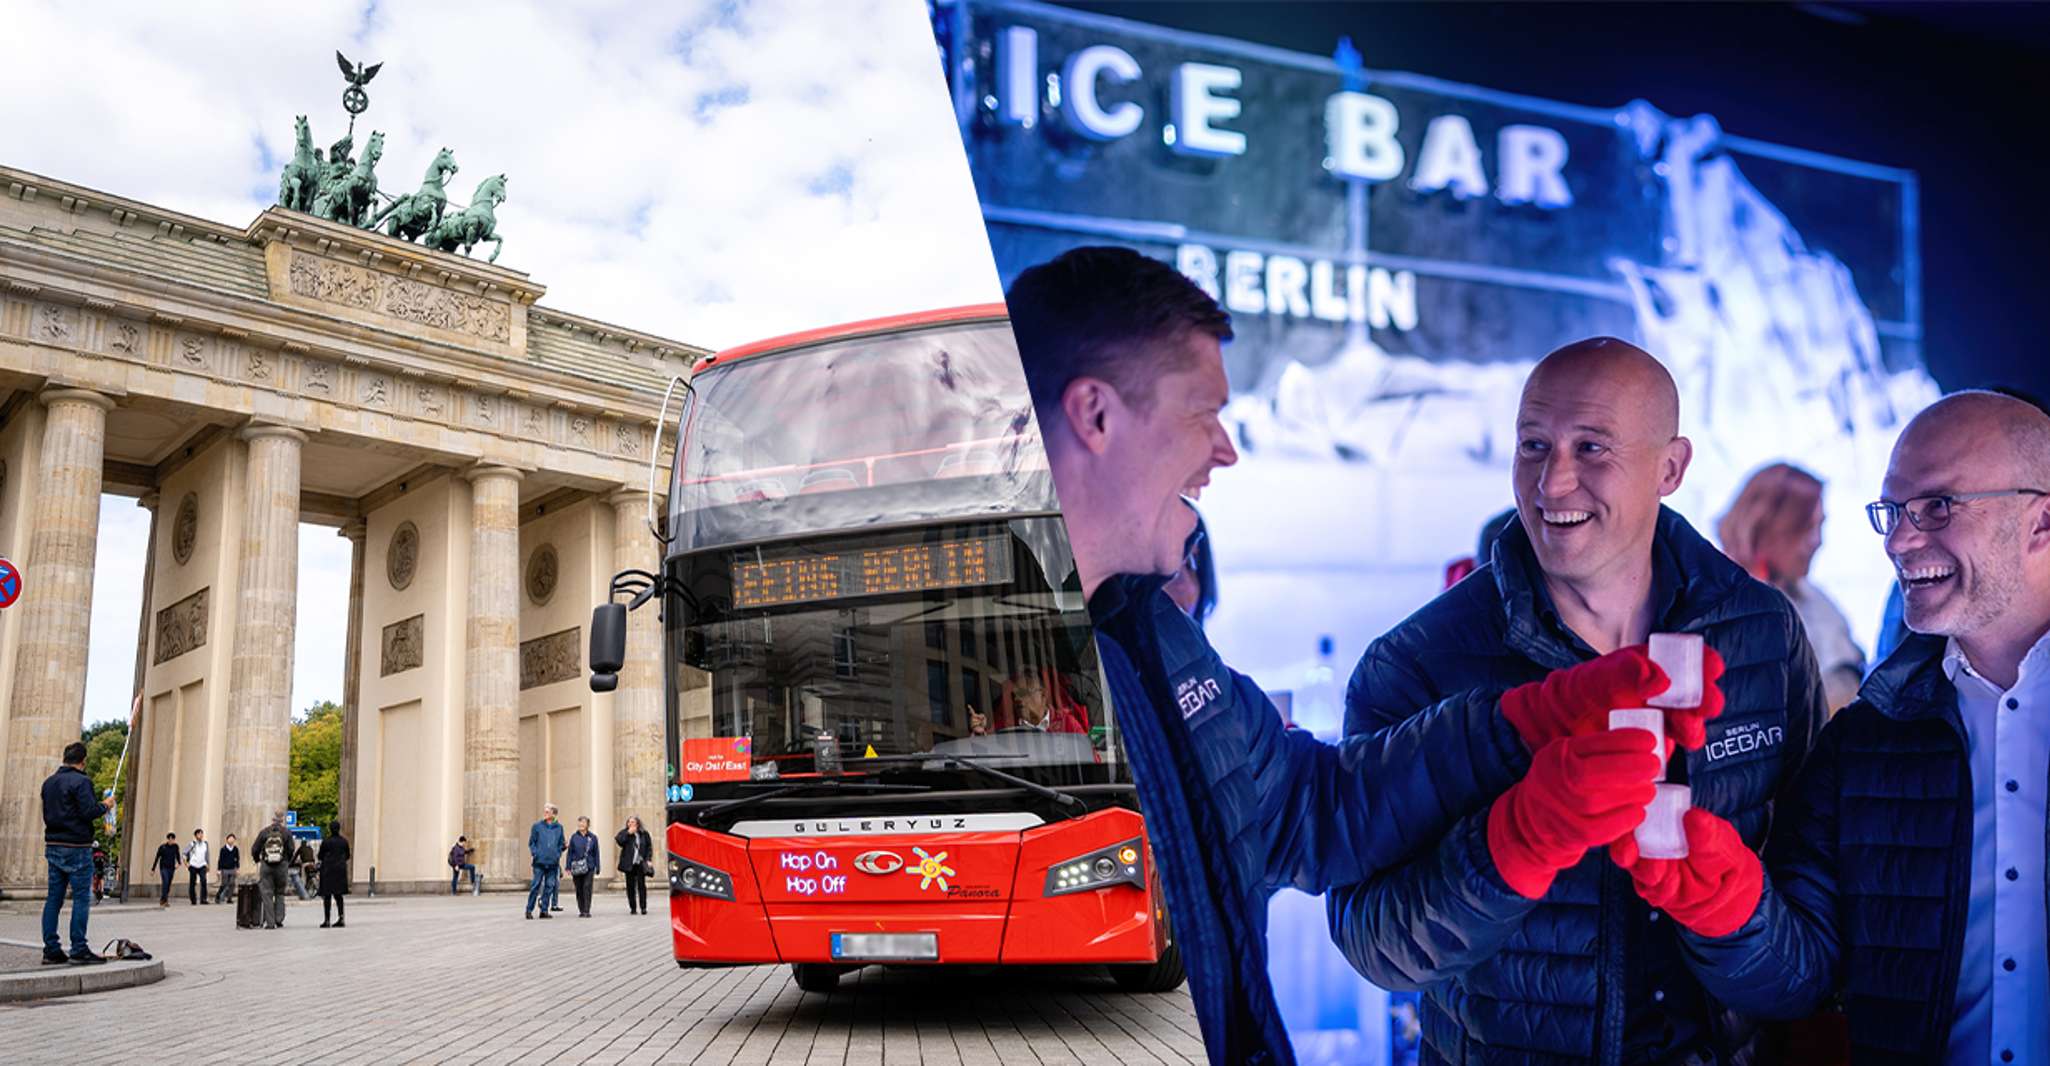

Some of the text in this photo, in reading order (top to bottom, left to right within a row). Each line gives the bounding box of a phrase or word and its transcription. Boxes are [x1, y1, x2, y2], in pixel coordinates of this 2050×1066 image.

[1005, 25, 1573, 209] ICE BAR
[1177, 243, 1418, 331] BERLIN
[733, 540, 987, 606] EEING BERLIN
[1725, 721, 1760, 737] BERLIN
[1705, 726, 1783, 762] ICEBAR
[686, 761, 704, 773] City
[780, 851, 838, 872] Hop On
[785, 875, 847, 895] Hop Off
